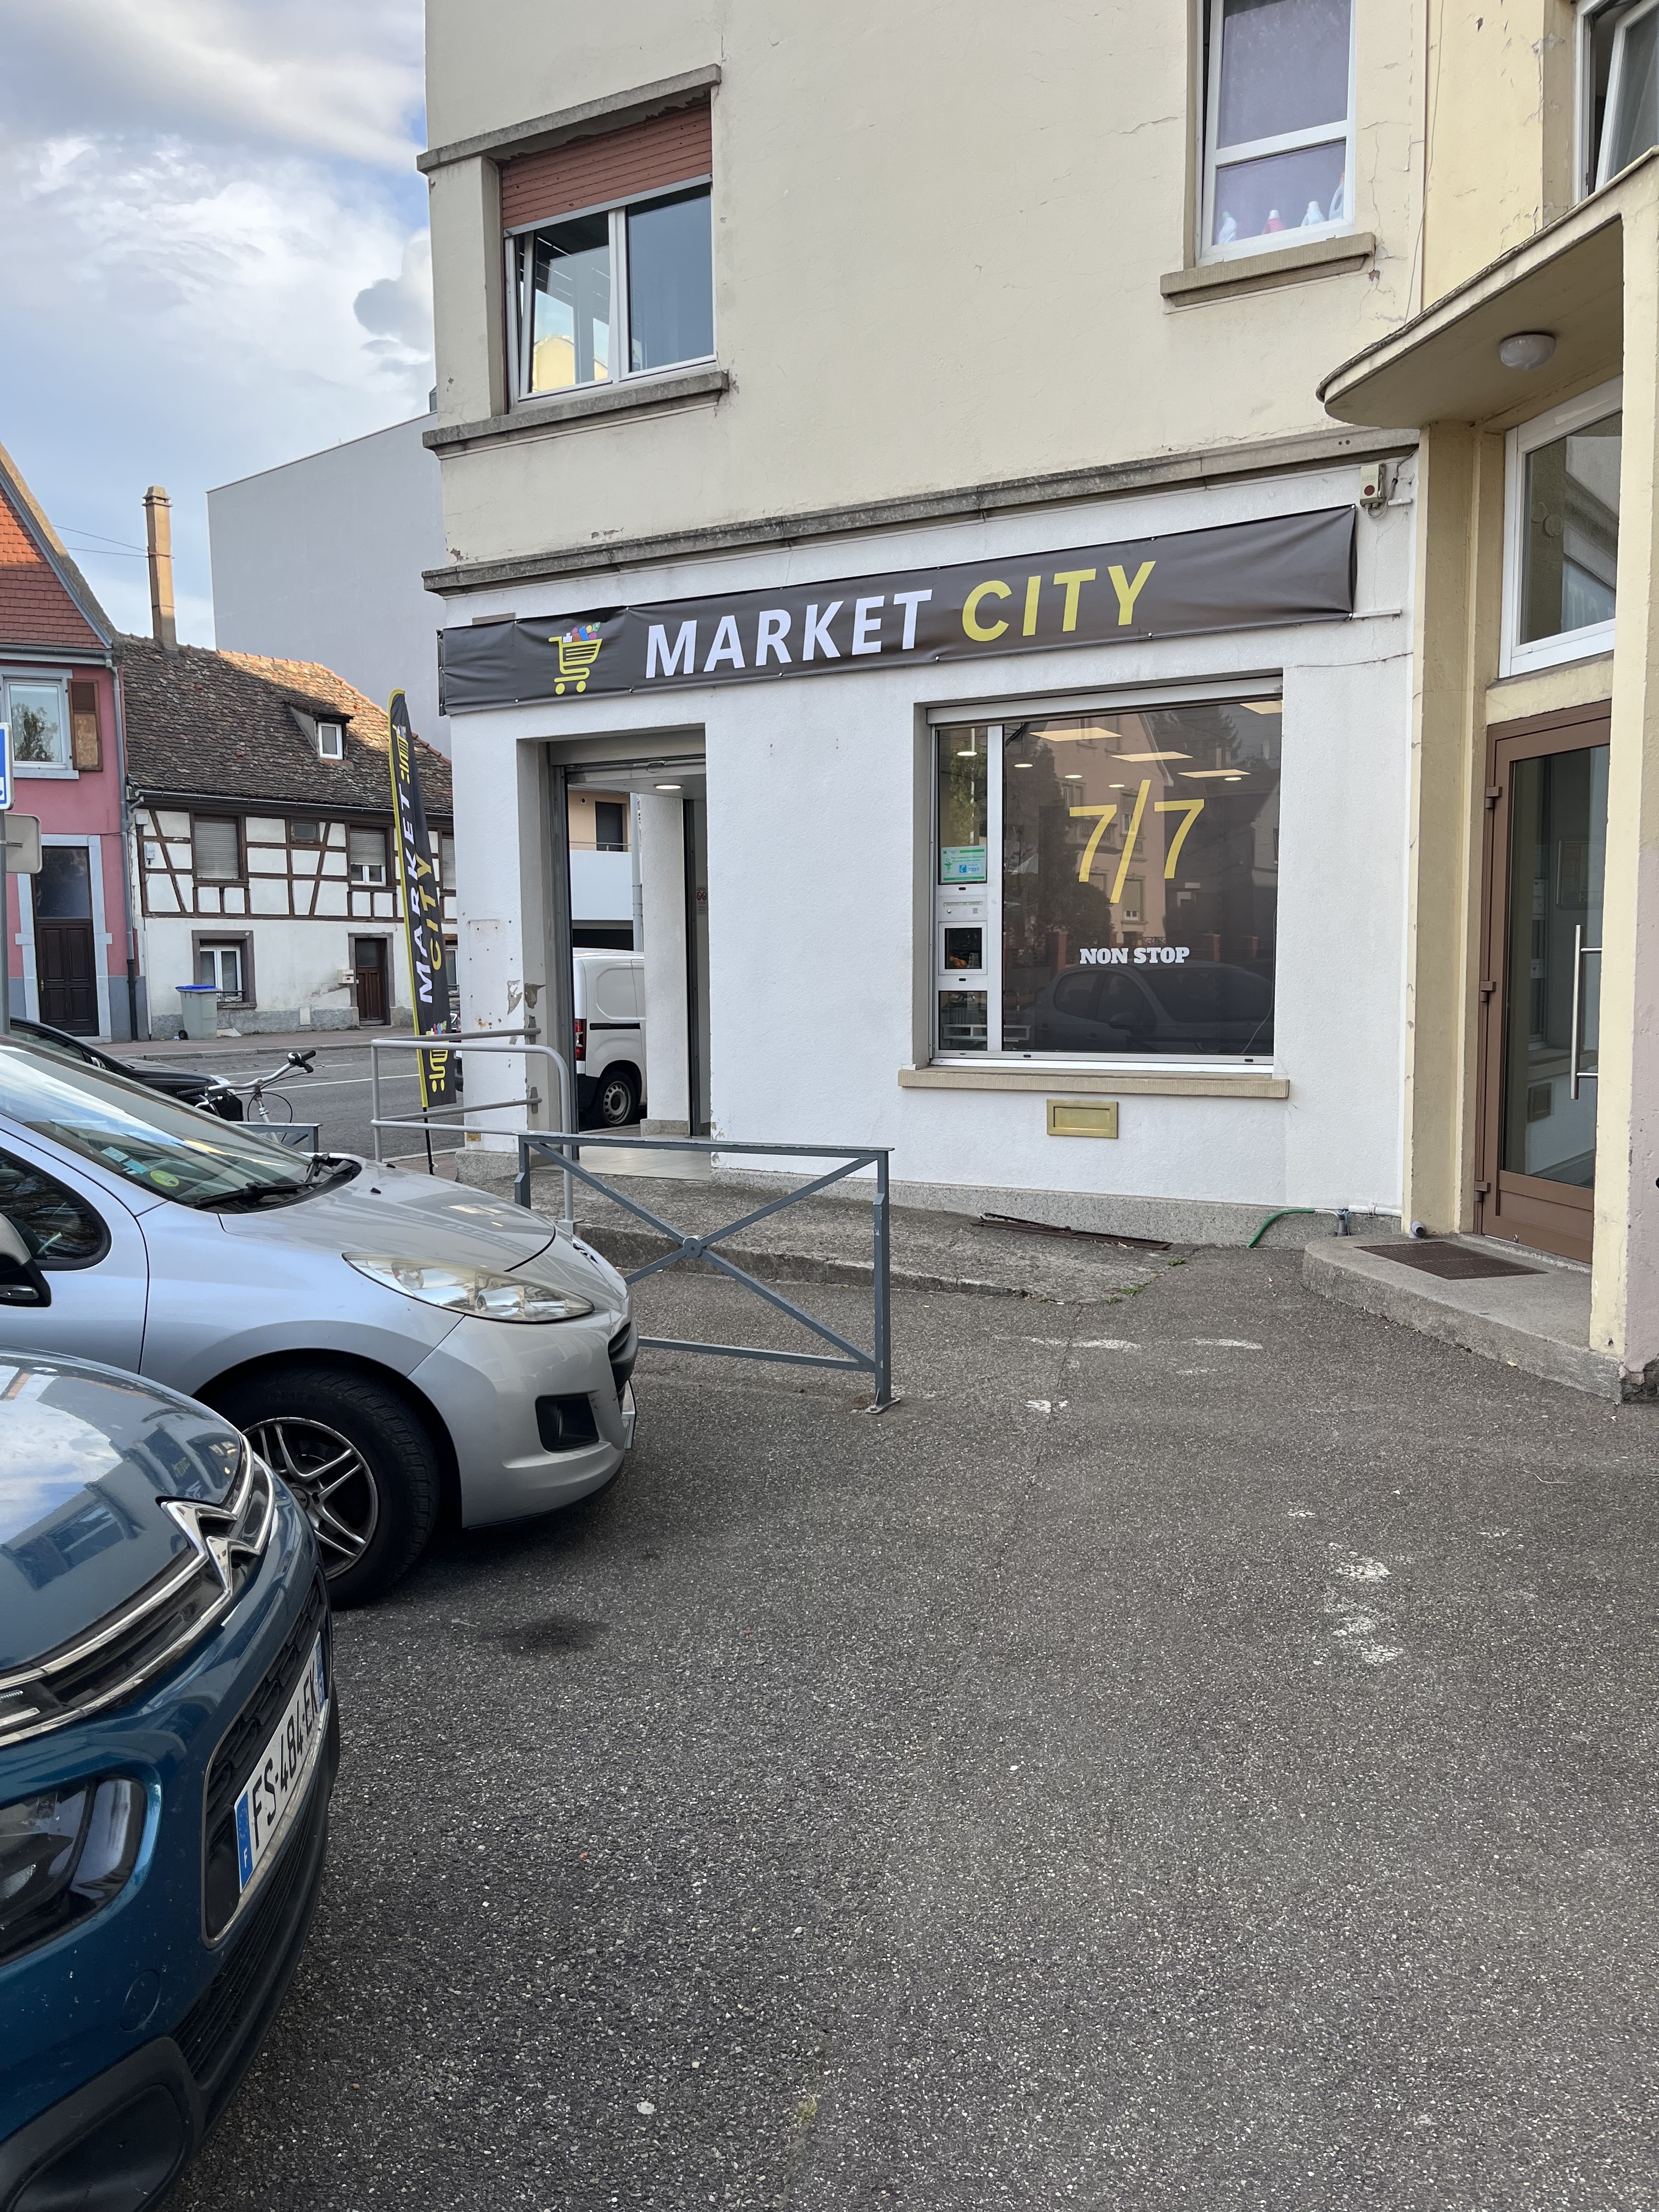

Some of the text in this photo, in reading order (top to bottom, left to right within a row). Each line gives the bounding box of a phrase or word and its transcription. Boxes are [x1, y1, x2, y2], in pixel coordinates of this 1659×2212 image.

[646, 561, 1156, 679] MARKET CITY
[398, 782, 433, 1004] MARKET
[1069, 779, 1205, 904] 7/7
[415, 854, 442, 970] CITY
[1080, 947, 1190, 964] NON STOP
[251, 1660, 319, 1850] FS-484-EK
[243, 1846, 249, 1870] F
